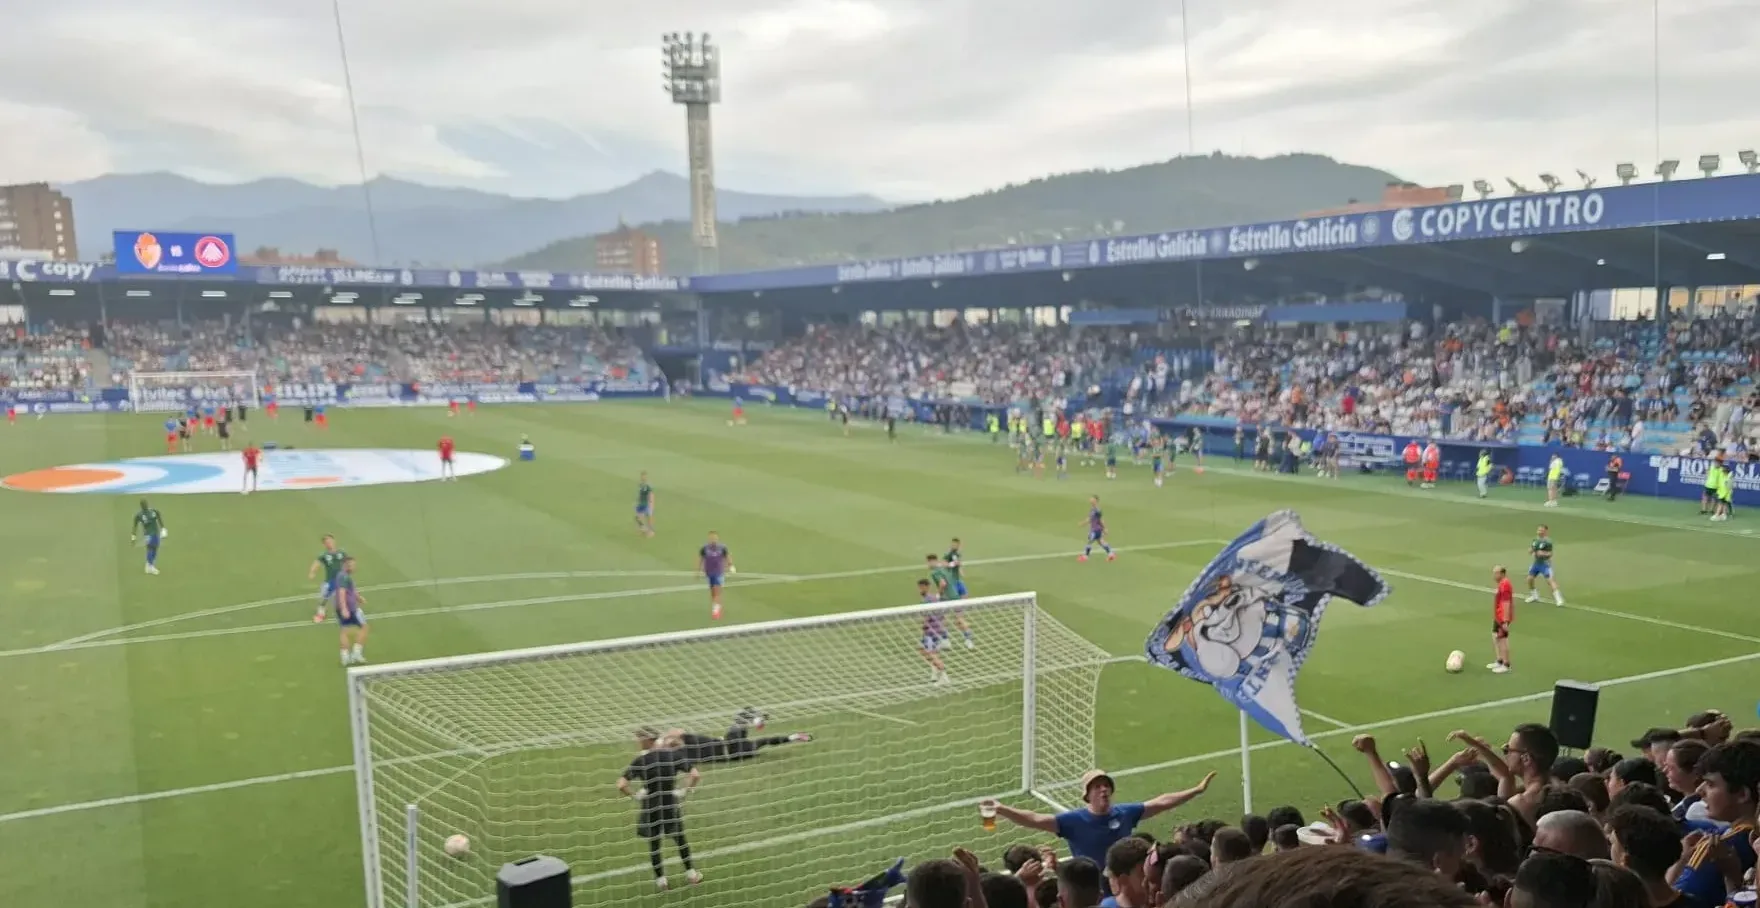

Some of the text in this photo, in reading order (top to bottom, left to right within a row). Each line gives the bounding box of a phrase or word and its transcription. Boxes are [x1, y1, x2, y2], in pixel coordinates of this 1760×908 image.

[1420, 192, 1605, 237] COPYCENTRO
[1107, 230, 1207, 263] Estrella Galicia
[1228, 216, 1357, 252] Estrella Galicia
[42, 262, 94, 280] copy
